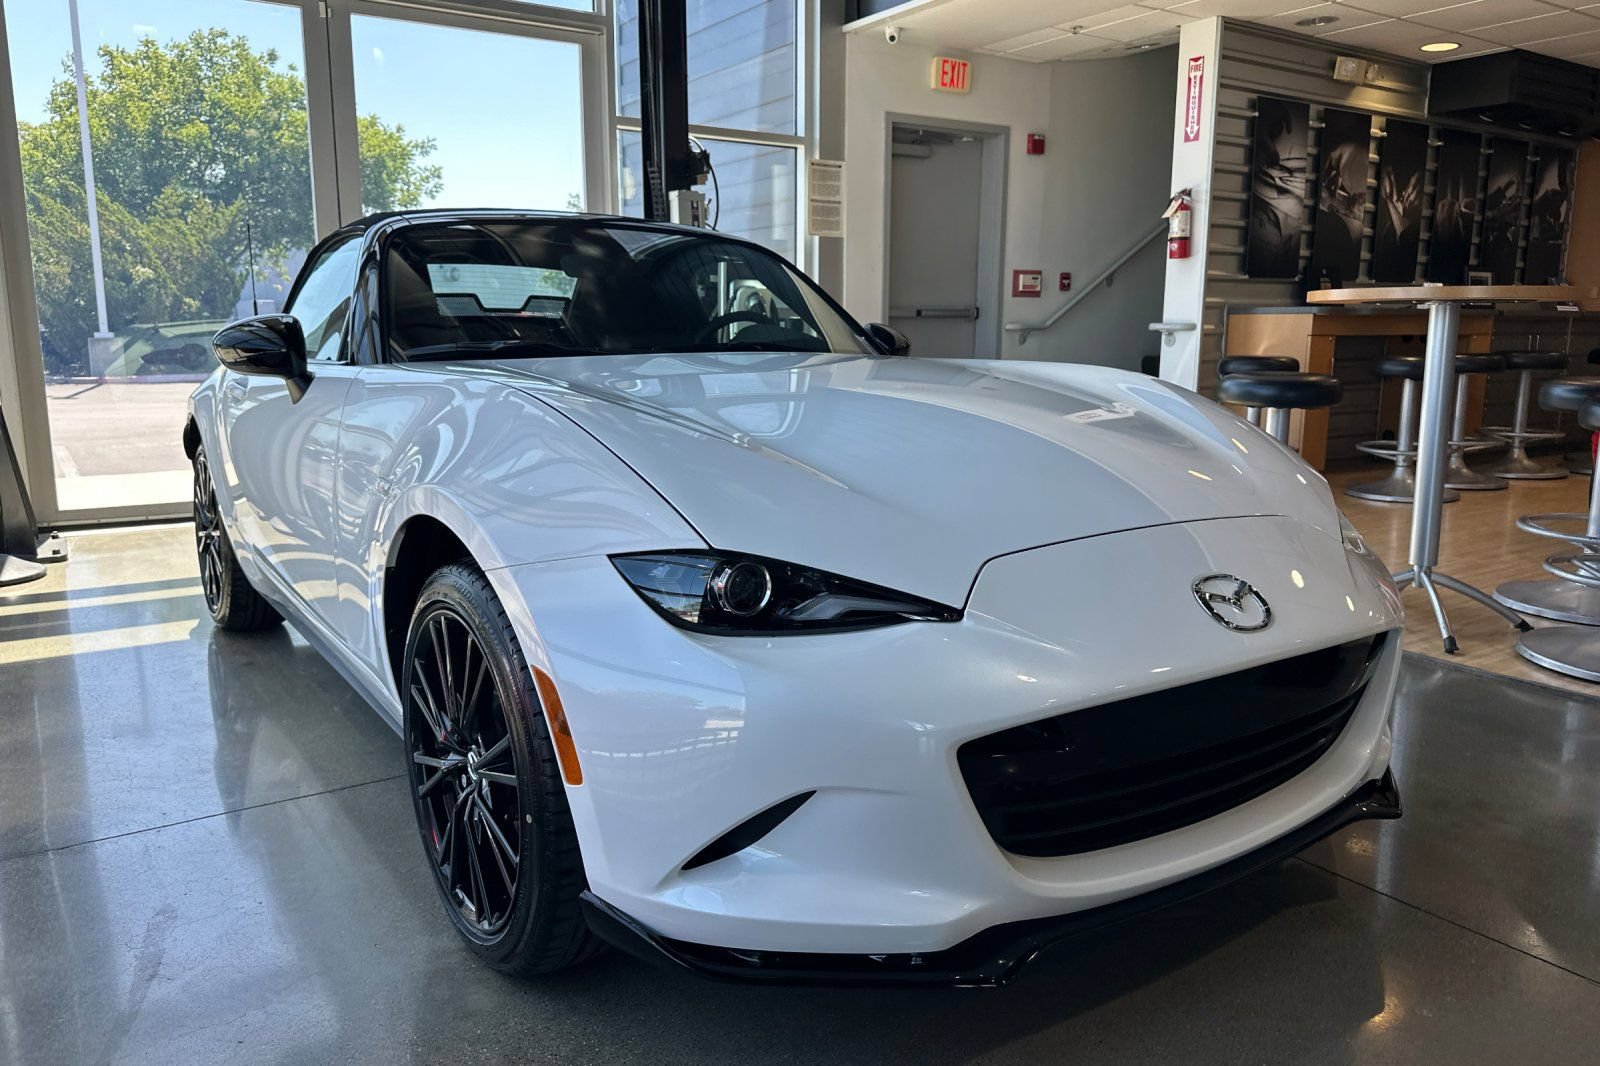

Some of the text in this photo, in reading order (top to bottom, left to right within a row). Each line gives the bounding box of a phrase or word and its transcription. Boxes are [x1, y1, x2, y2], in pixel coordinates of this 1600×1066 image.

[941, 59, 968, 89] EXIT
[1190, 63, 1202, 73] FIRE
[1190, 75, 1198, 134] EXTINGUISHER
